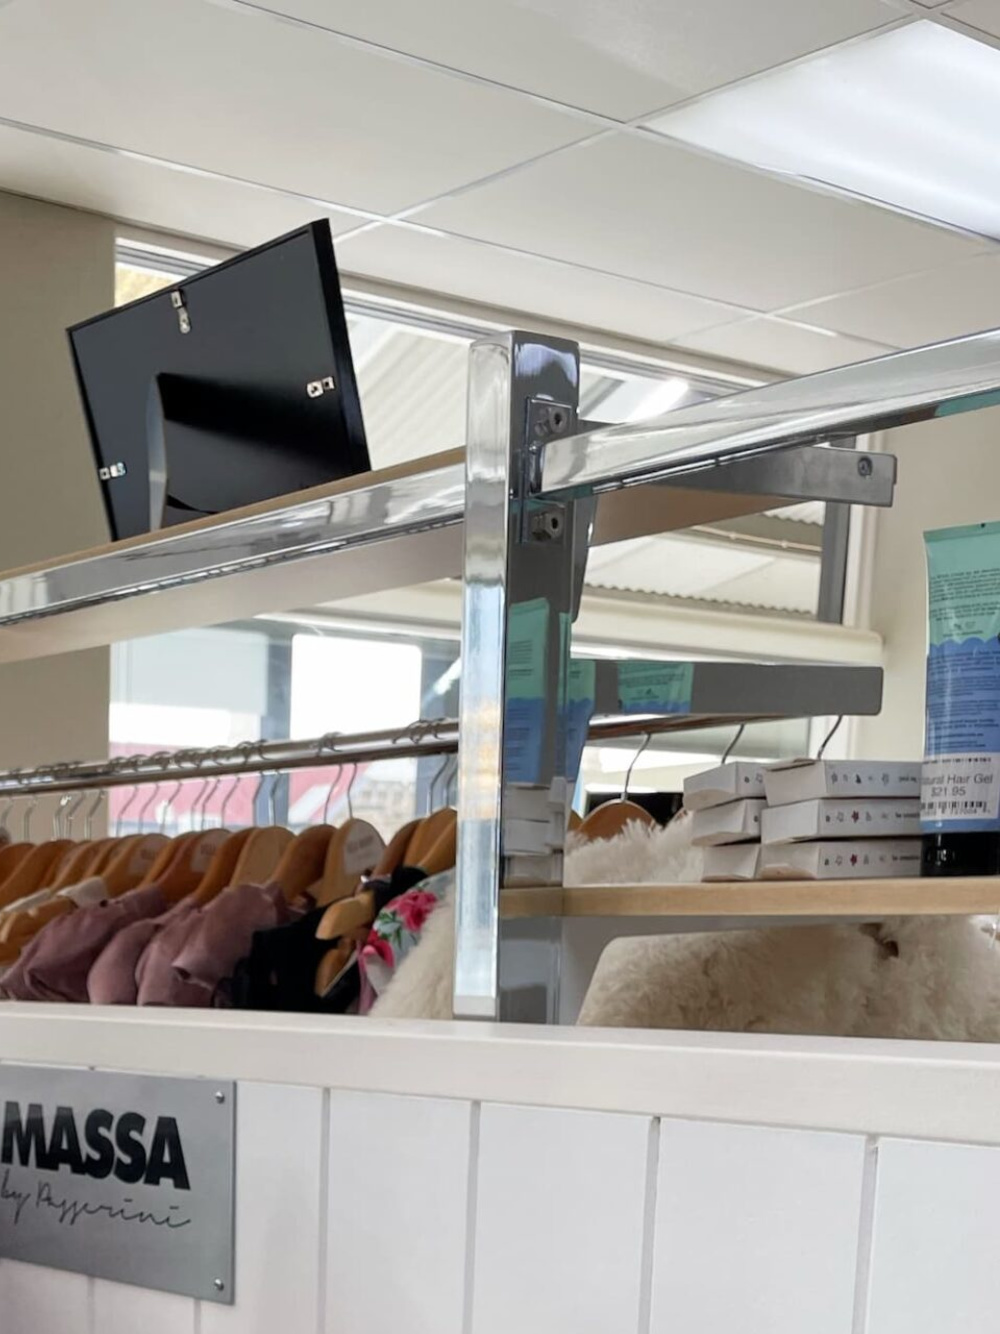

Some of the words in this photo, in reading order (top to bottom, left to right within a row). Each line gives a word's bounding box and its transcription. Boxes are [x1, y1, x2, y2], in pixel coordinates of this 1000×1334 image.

[947, 774, 970, 785] Hair
[974, 773, 993, 784] Gel
[1, 1101, 190, 1190] MASSA
[1, 1168, 30, 1225] by
